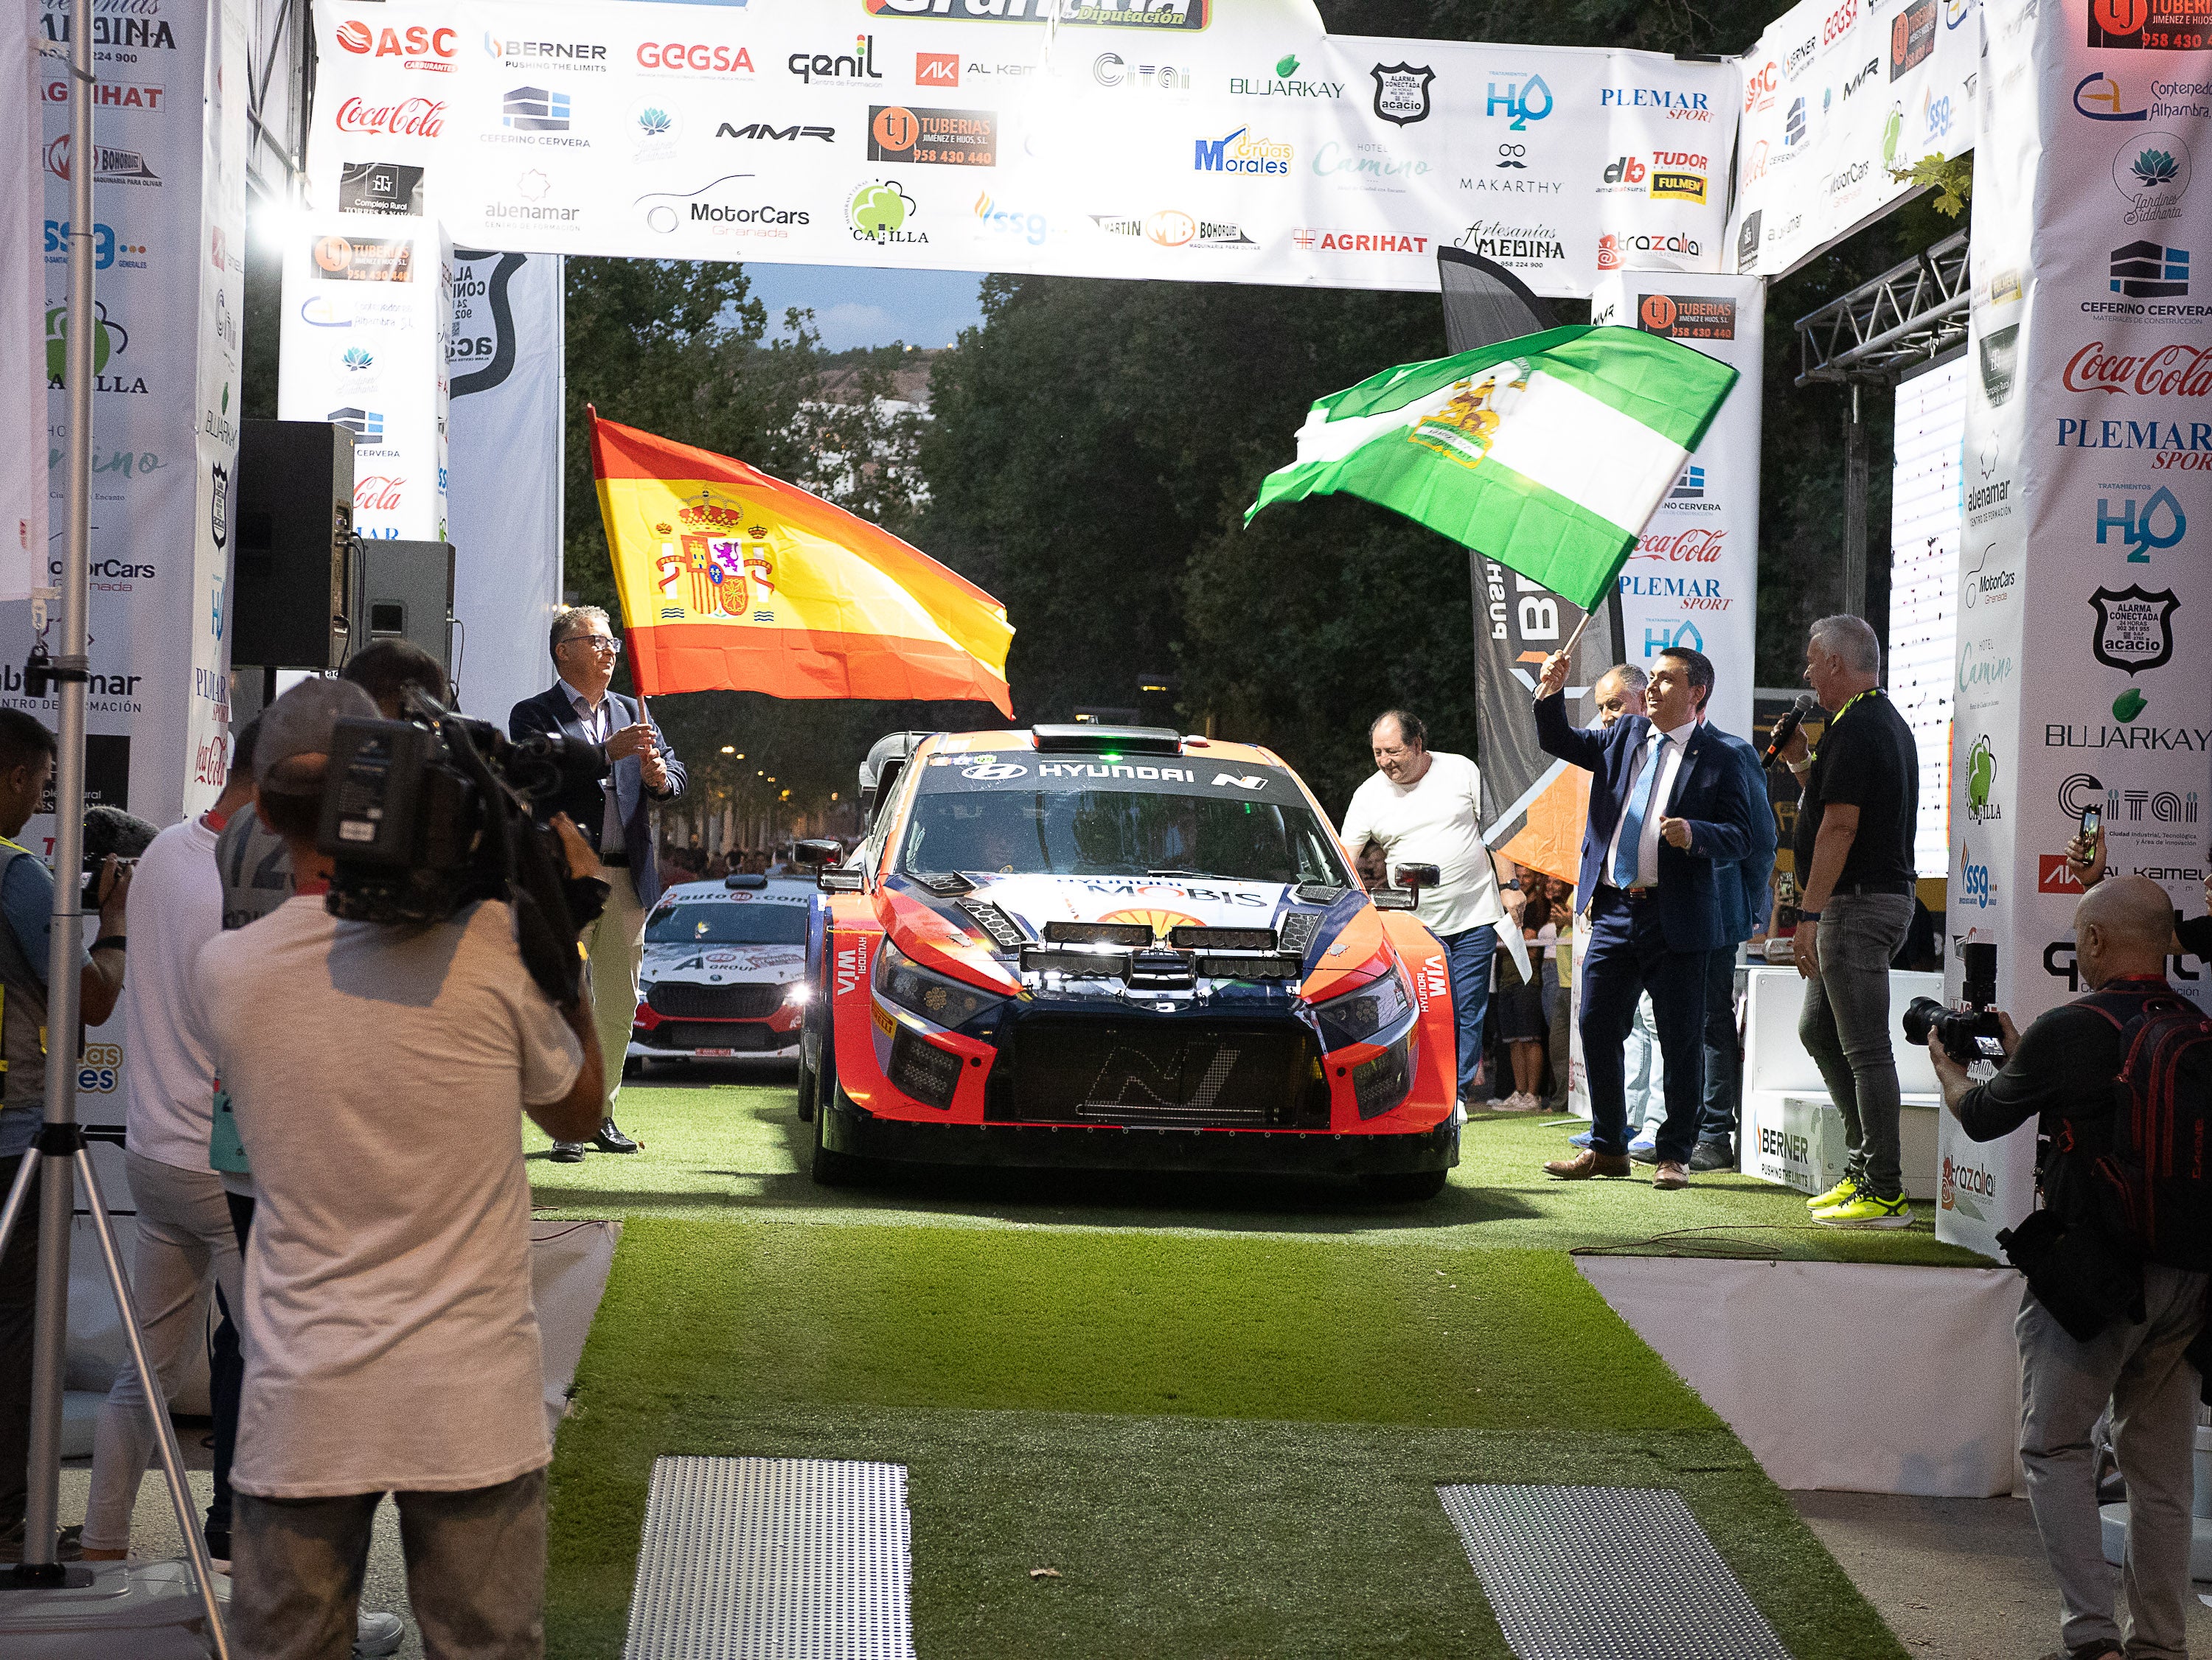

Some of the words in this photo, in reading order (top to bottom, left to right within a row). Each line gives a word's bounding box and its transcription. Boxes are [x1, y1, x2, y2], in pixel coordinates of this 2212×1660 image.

[1076, 5, 1184, 24] Diputación
[2152, 13, 2184, 25] JIMÉNEZ
[2185, 15, 2191, 24] E
[375, 25, 459, 57] ASC
[2142, 33, 2168, 46] 958
[2174, 34, 2202, 48] 430
[115, 53, 138, 63] 900
[506, 41, 607, 60] BERNER
[505, 60, 551, 70] PUSHING
[573, 64, 607, 72] LIMITS
[967, 63, 991, 74] AL
[1231, 78, 1345, 99] BUJARKAY
[1382, 100, 1422, 110] acacio
[1601, 88, 1708, 111] PLEMAR
[1666, 108, 1714, 124] SPORT
[715, 122, 835, 142] MMR
[922, 117, 990, 136] TUBERIAS
[480, 134, 535, 144] CEFERINO
[538, 137, 591, 147] CERVERA
[1357, 143, 1388, 153] HOTEL
[914, 148, 936, 162] 958
[939, 150, 964, 163] 430
[968, 151, 991, 165] 440
[1195, 140, 1287, 174] Morales
[1312, 142, 1433, 177] Camino
[1652, 151, 1708, 170] TUDOR
[1460, 178, 1562, 194] MAKARTHY
[1659, 178, 1700, 192] FULMEN
[354, 198, 389, 209] Complejo
[390, 202, 408, 210] Rural
[485, 202, 580, 221] abenamar
[2133, 192, 2177, 212] Jardines
[691, 203, 810, 225] MotorCars
[712, 225, 788, 238] Granada
[993, 212, 1047, 246] ssg
[1321, 233, 1428, 253] AGRIHAT
[1677, 303, 1731, 316] TUBERIAS
[2080, 301, 2146, 315] CEFERINO
[2147, 303, 2212, 316] CERVERA
[2093, 315, 2132, 324] MATERIALES
[2133, 316, 2143, 324] DE
[2144, 316, 2202, 325] CONSTRUCCIÓN
[1672, 327, 1690, 337] 958
[1692, 328, 1711, 338] 430
[1713, 329, 1732, 338] 440
[2055, 417, 2212, 451] PLEMAR
[356, 449, 400, 458] CERVERA
[1968, 480, 2011, 512] abenamar
[2098, 483, 2152, 491] TRATAMIENTOS
[1619, 576, 1722, 598] PLEMAR
[1979, 571, 2015, 593] MotorCars
[1680, 598, 1733, 611] SPORT
[2118, 604, 2152, 613] ALARMA
[2110, 612, 2159, 621] CONECTADA
[2104, 638, 2160, 651] acacio
[1959, 641, 2013, 693] Camino
[2045, 724, 2212, 752] BUJARKAY
[1038, 764, 1194, 783] HYUNDAI
[1088, 885, 1267, 907] MOBIS
[1966, 865, 1989, 909] ssg
[858, 936, 867, 974] HYUNDAI
[1416, 972, 1430, 1013] HYUNDAI
[1762, 1128, 1809, 1165] BERNER
